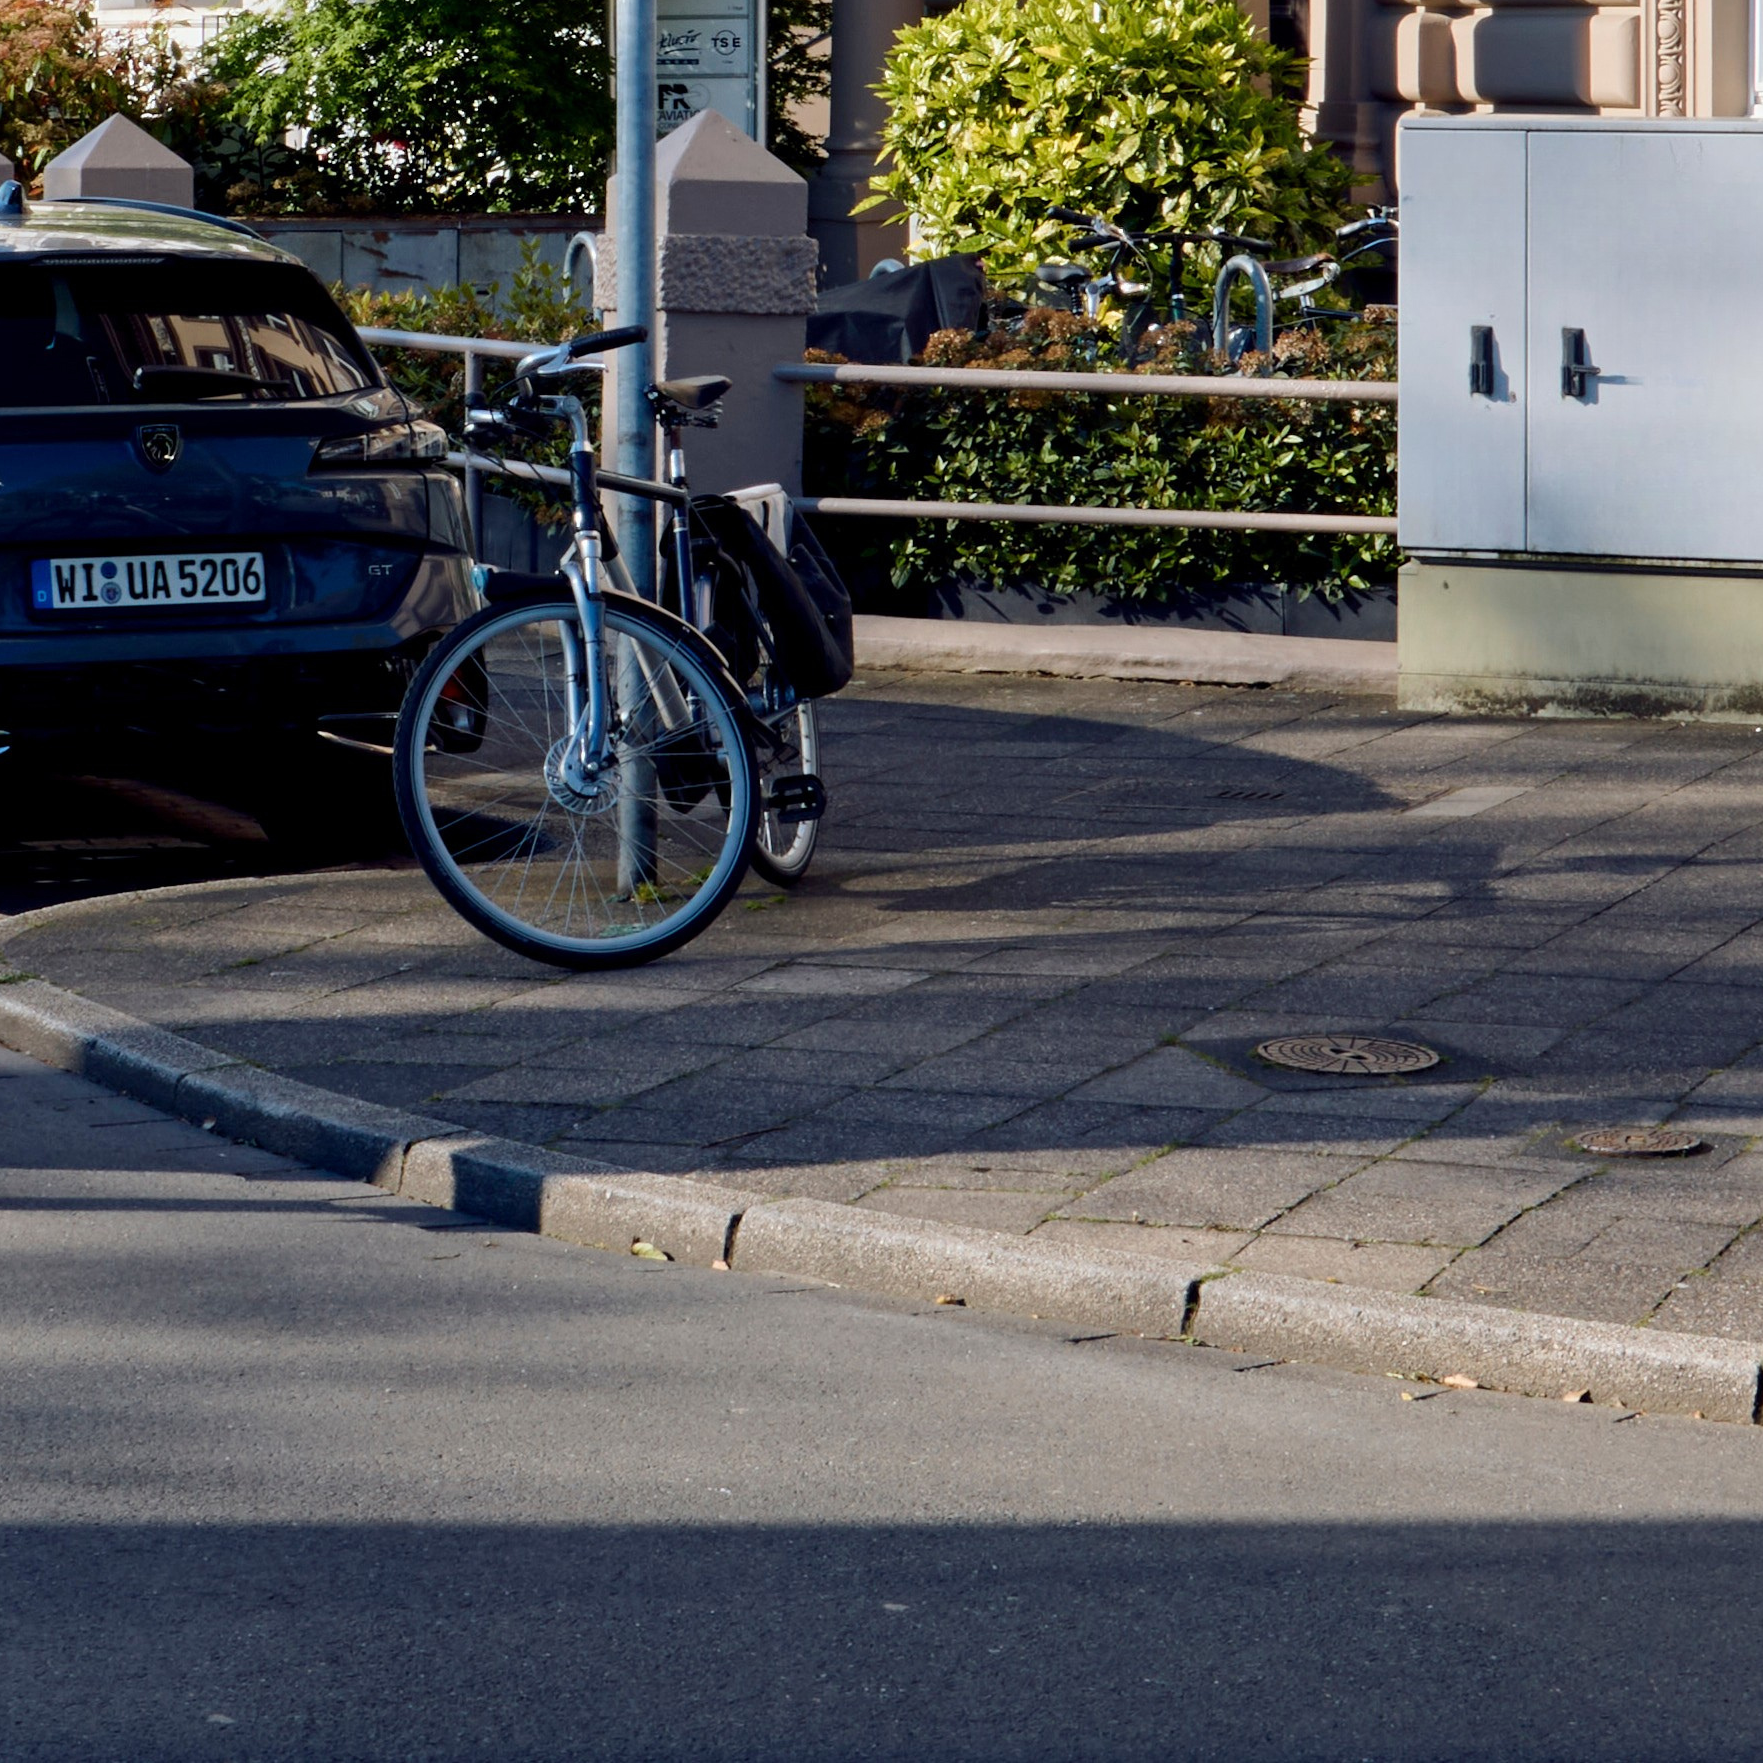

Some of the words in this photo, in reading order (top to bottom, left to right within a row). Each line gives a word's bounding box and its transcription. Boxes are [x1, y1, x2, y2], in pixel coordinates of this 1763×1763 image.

[37, 590, 47, 602] D
[54, 562, 99, 604] WI
[126, 560, 172, 601] UA
[177, 556, 262, 599] 5206
[368, 564, 393, 576] GT
